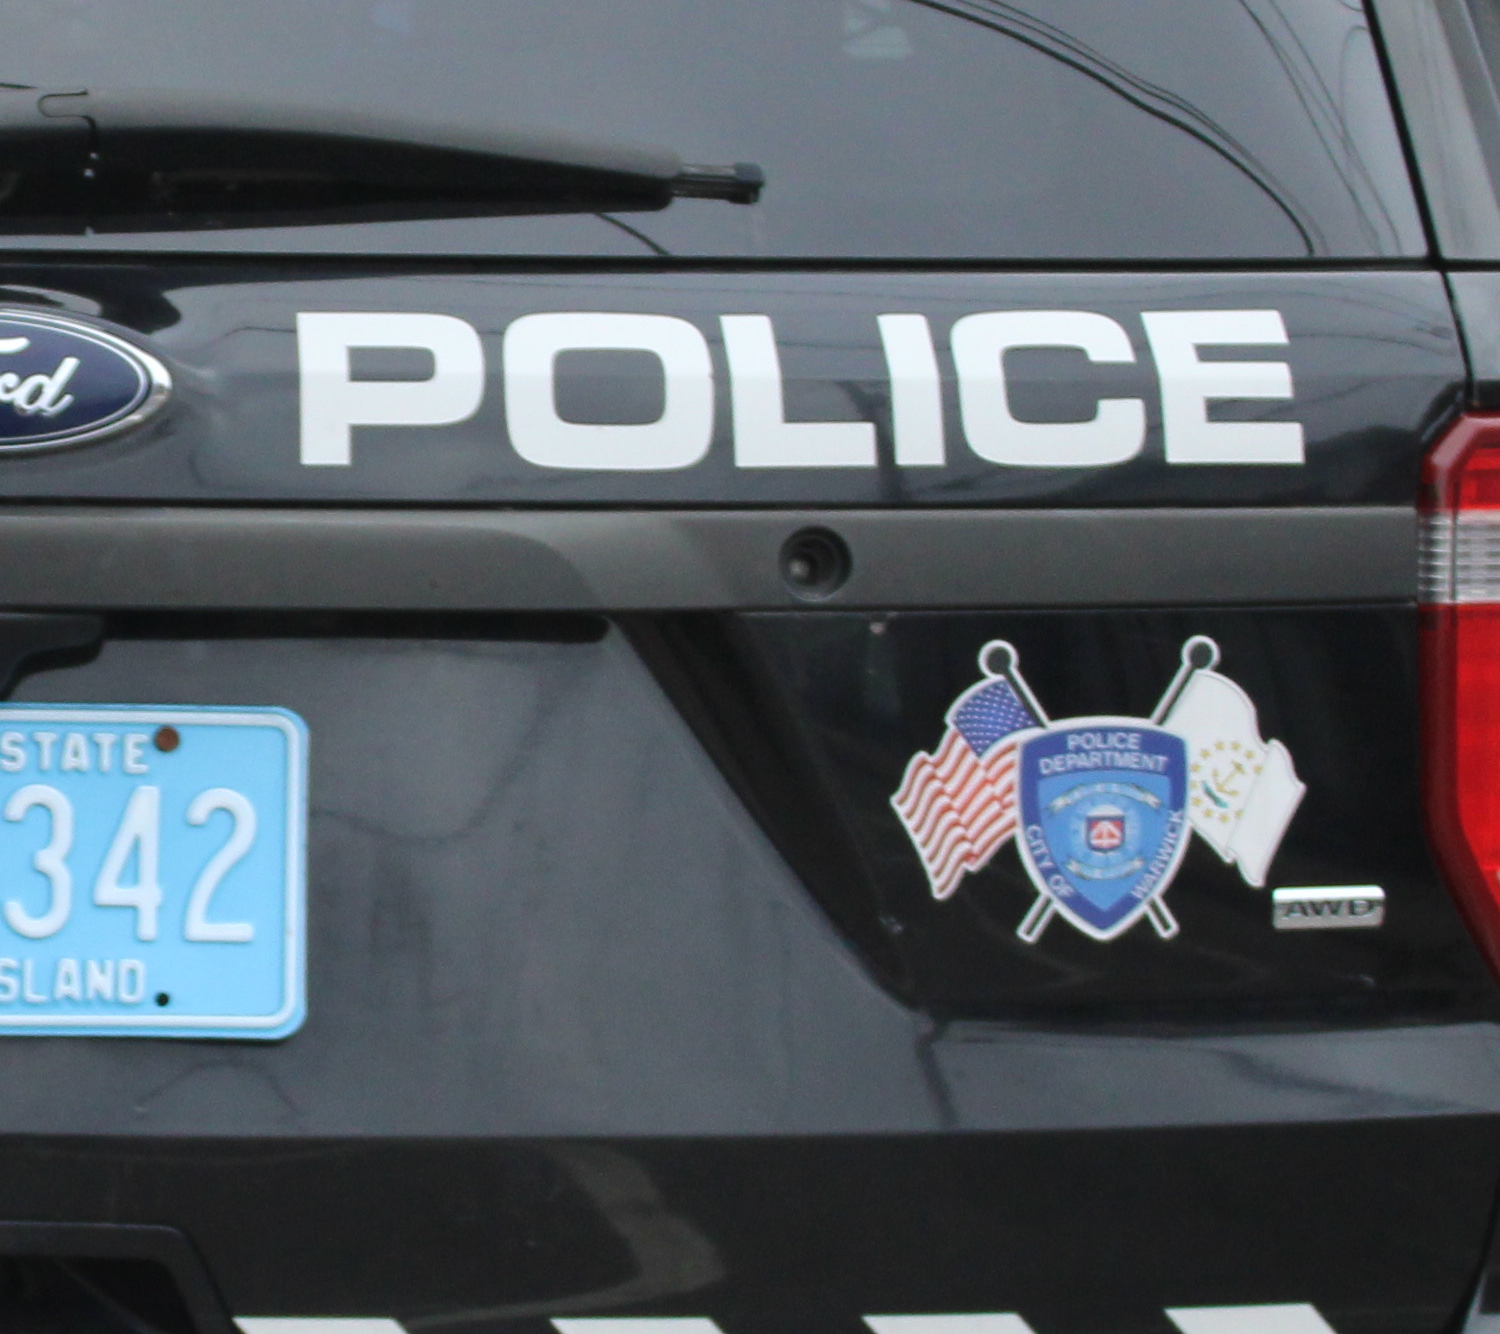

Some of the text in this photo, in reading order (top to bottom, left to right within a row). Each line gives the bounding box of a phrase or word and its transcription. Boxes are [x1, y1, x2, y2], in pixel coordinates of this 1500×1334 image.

[295, 309, 1305, 470] POLICE
[1038, 750, 1169, 776] DEPARTMENT
[1066, 731, 1143, 751] POLICE
[1027, 824, 1076, 899] CITY OF
[1130, 808, 1185, 900] WARWICK
[1279, 897, 1377, 920] AWD
